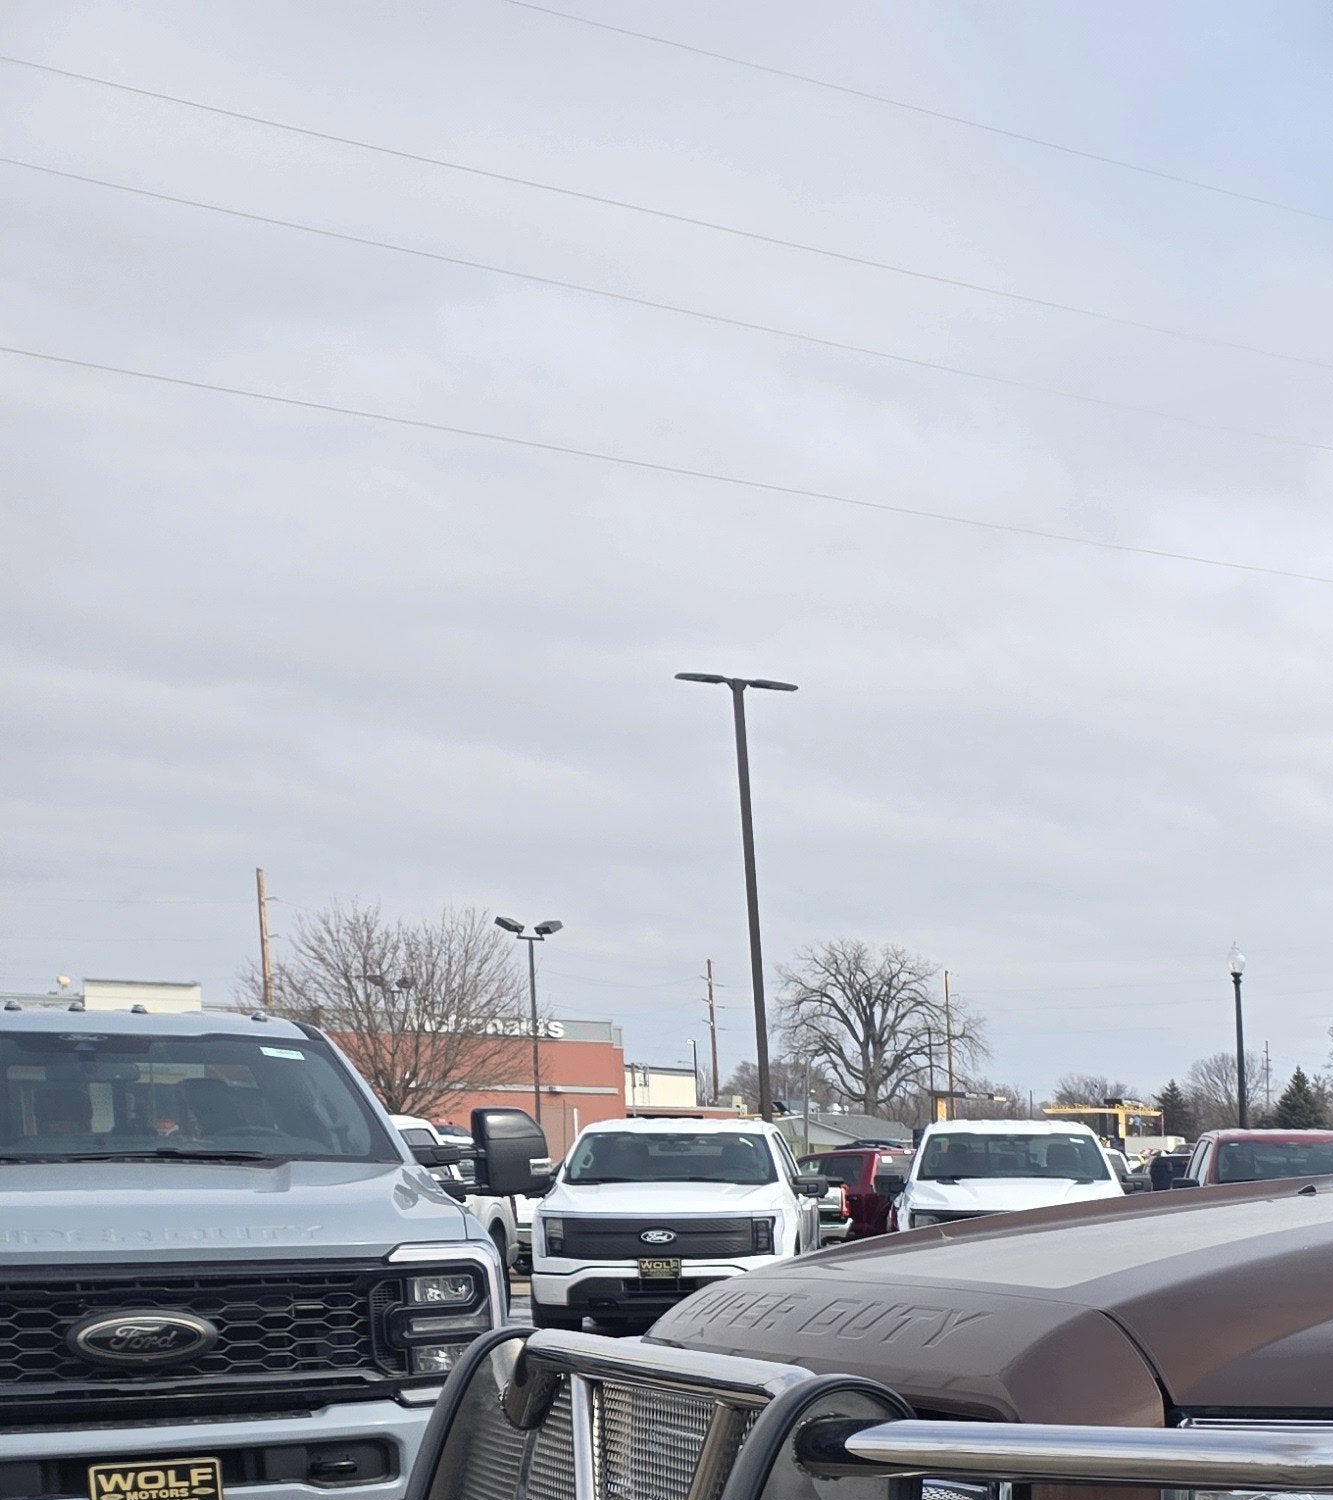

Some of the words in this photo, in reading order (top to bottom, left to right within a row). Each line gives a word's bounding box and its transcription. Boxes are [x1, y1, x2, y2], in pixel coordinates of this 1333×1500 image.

[672, 1289, 811, 1331] SUPER
[796, 1298, 995, 1349] DUTY
[109, 1325, 177, 1349] Ford
[97, 1467, 213, 1492] WOLF
[126, 1488, 189, 1500] MOTORS
